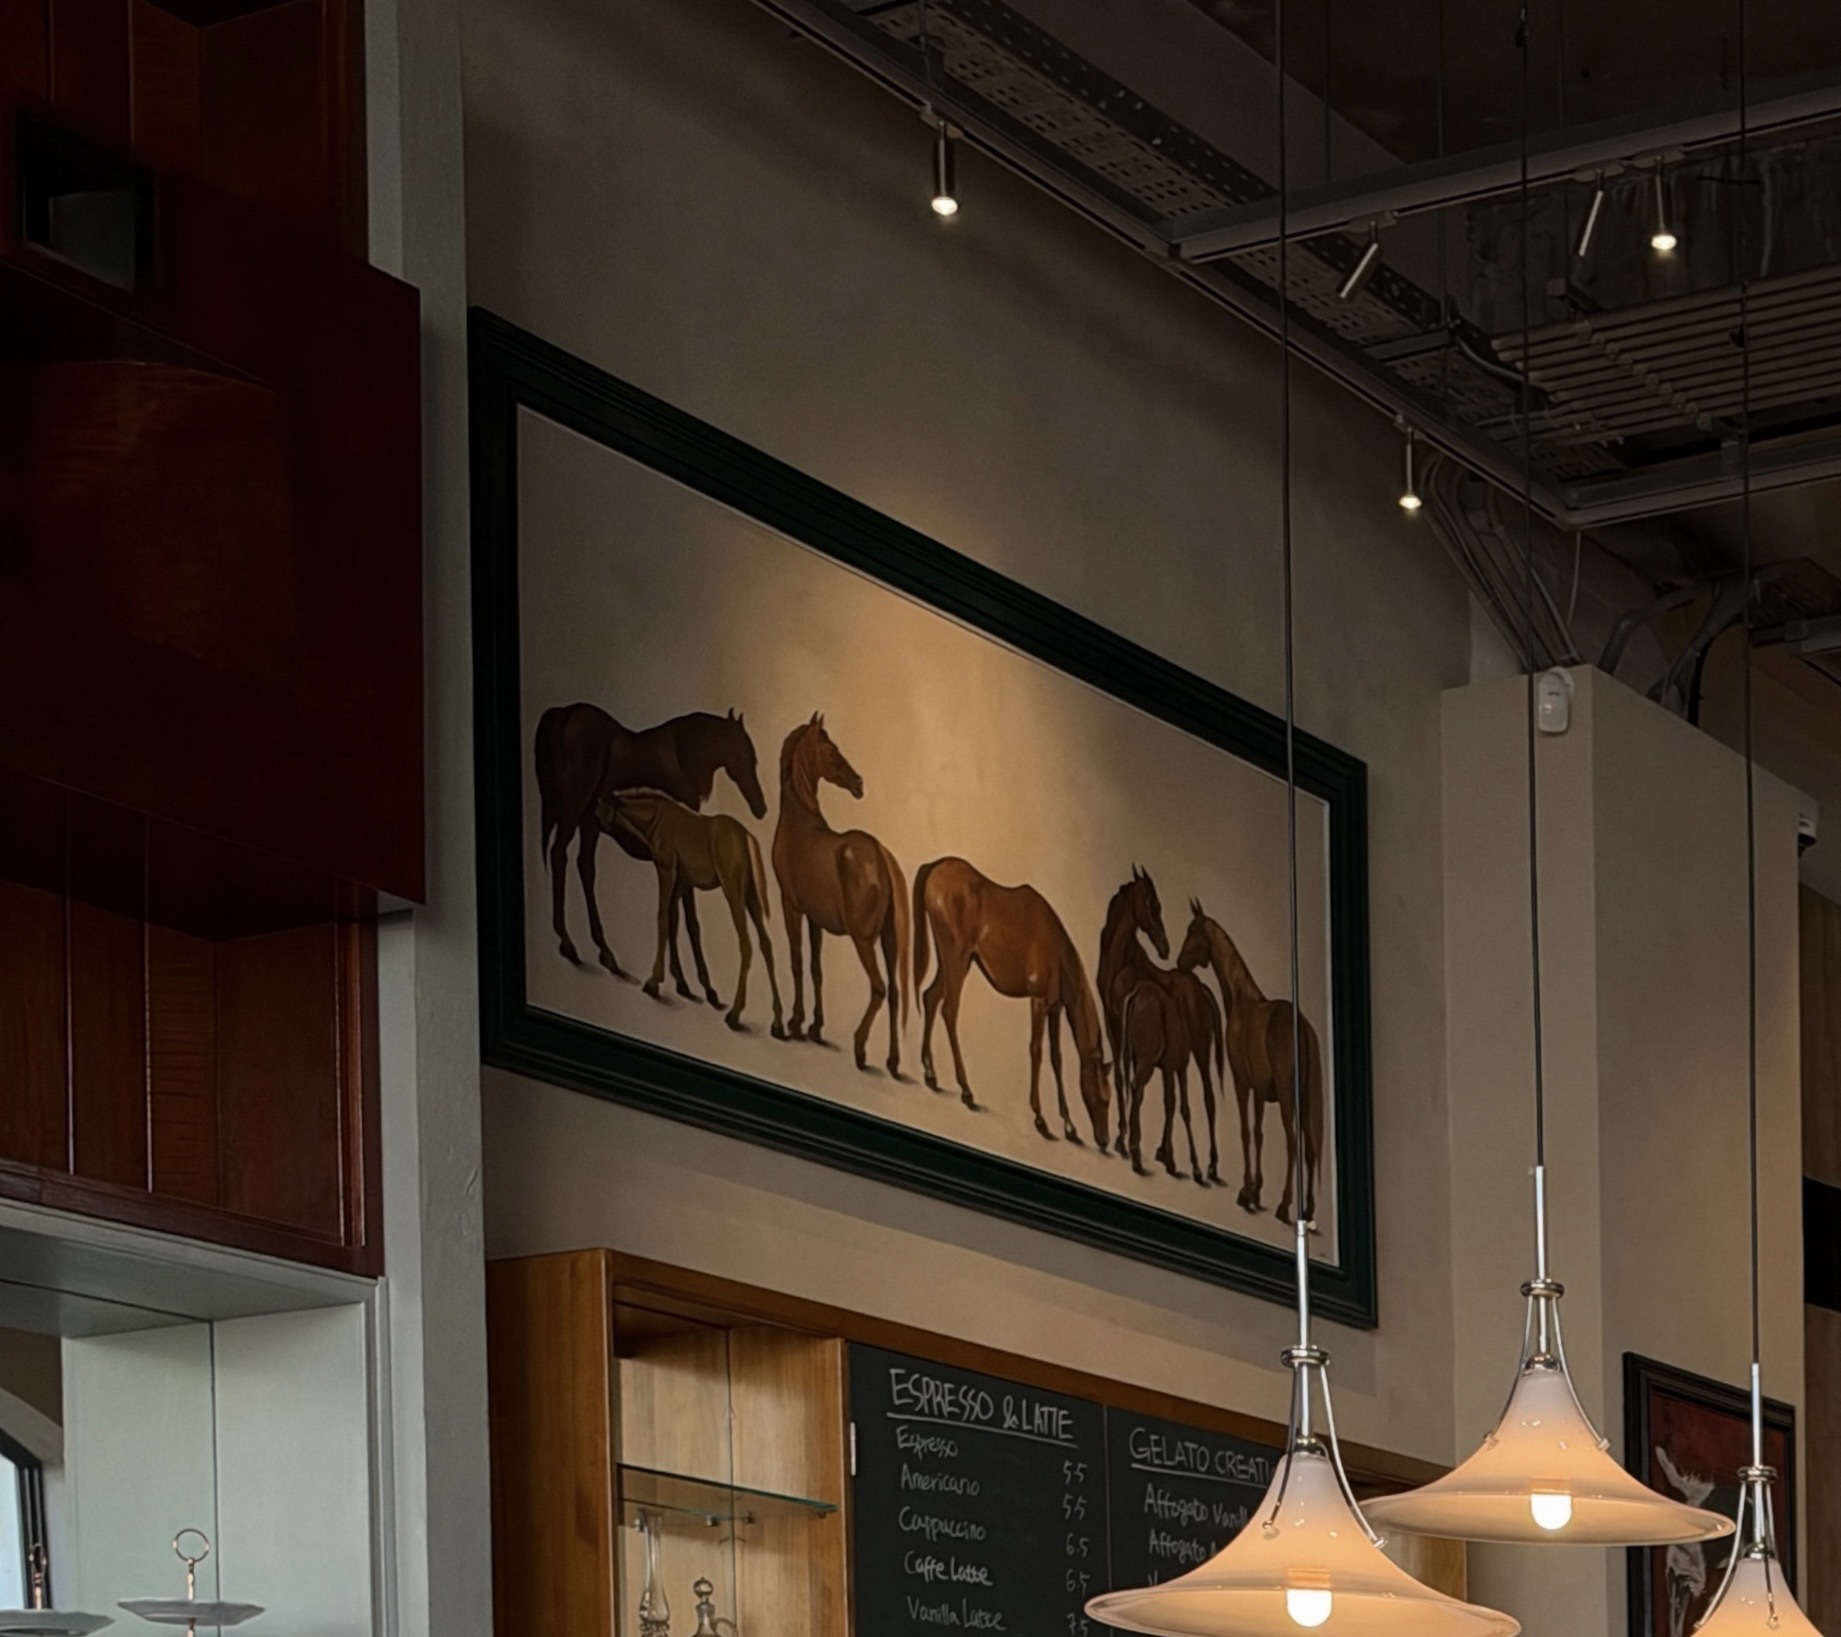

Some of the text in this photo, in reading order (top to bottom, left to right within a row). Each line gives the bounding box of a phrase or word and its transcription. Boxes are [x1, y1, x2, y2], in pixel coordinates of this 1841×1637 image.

[889, 1368, 994, 1421] ESPRESSO
[1022, 1399, 1074, 1439] LATTE
[896, 1425, 958, 1459] Espresso
[1129, 1427, 1271, 1483] GELATO CREATI
[901, 1463, 980, 1496] Americano
[899, 1506, 986, 1541] Cappuccino
[1144, 1483, 1249, 1529] Affogato Vanill
[1150, 1528, 1207, 1563] Affogato
[904, 1550, 994, 1586] Caffe Latte
[907, 1596, 1007, 1631] Vanilla Latte
